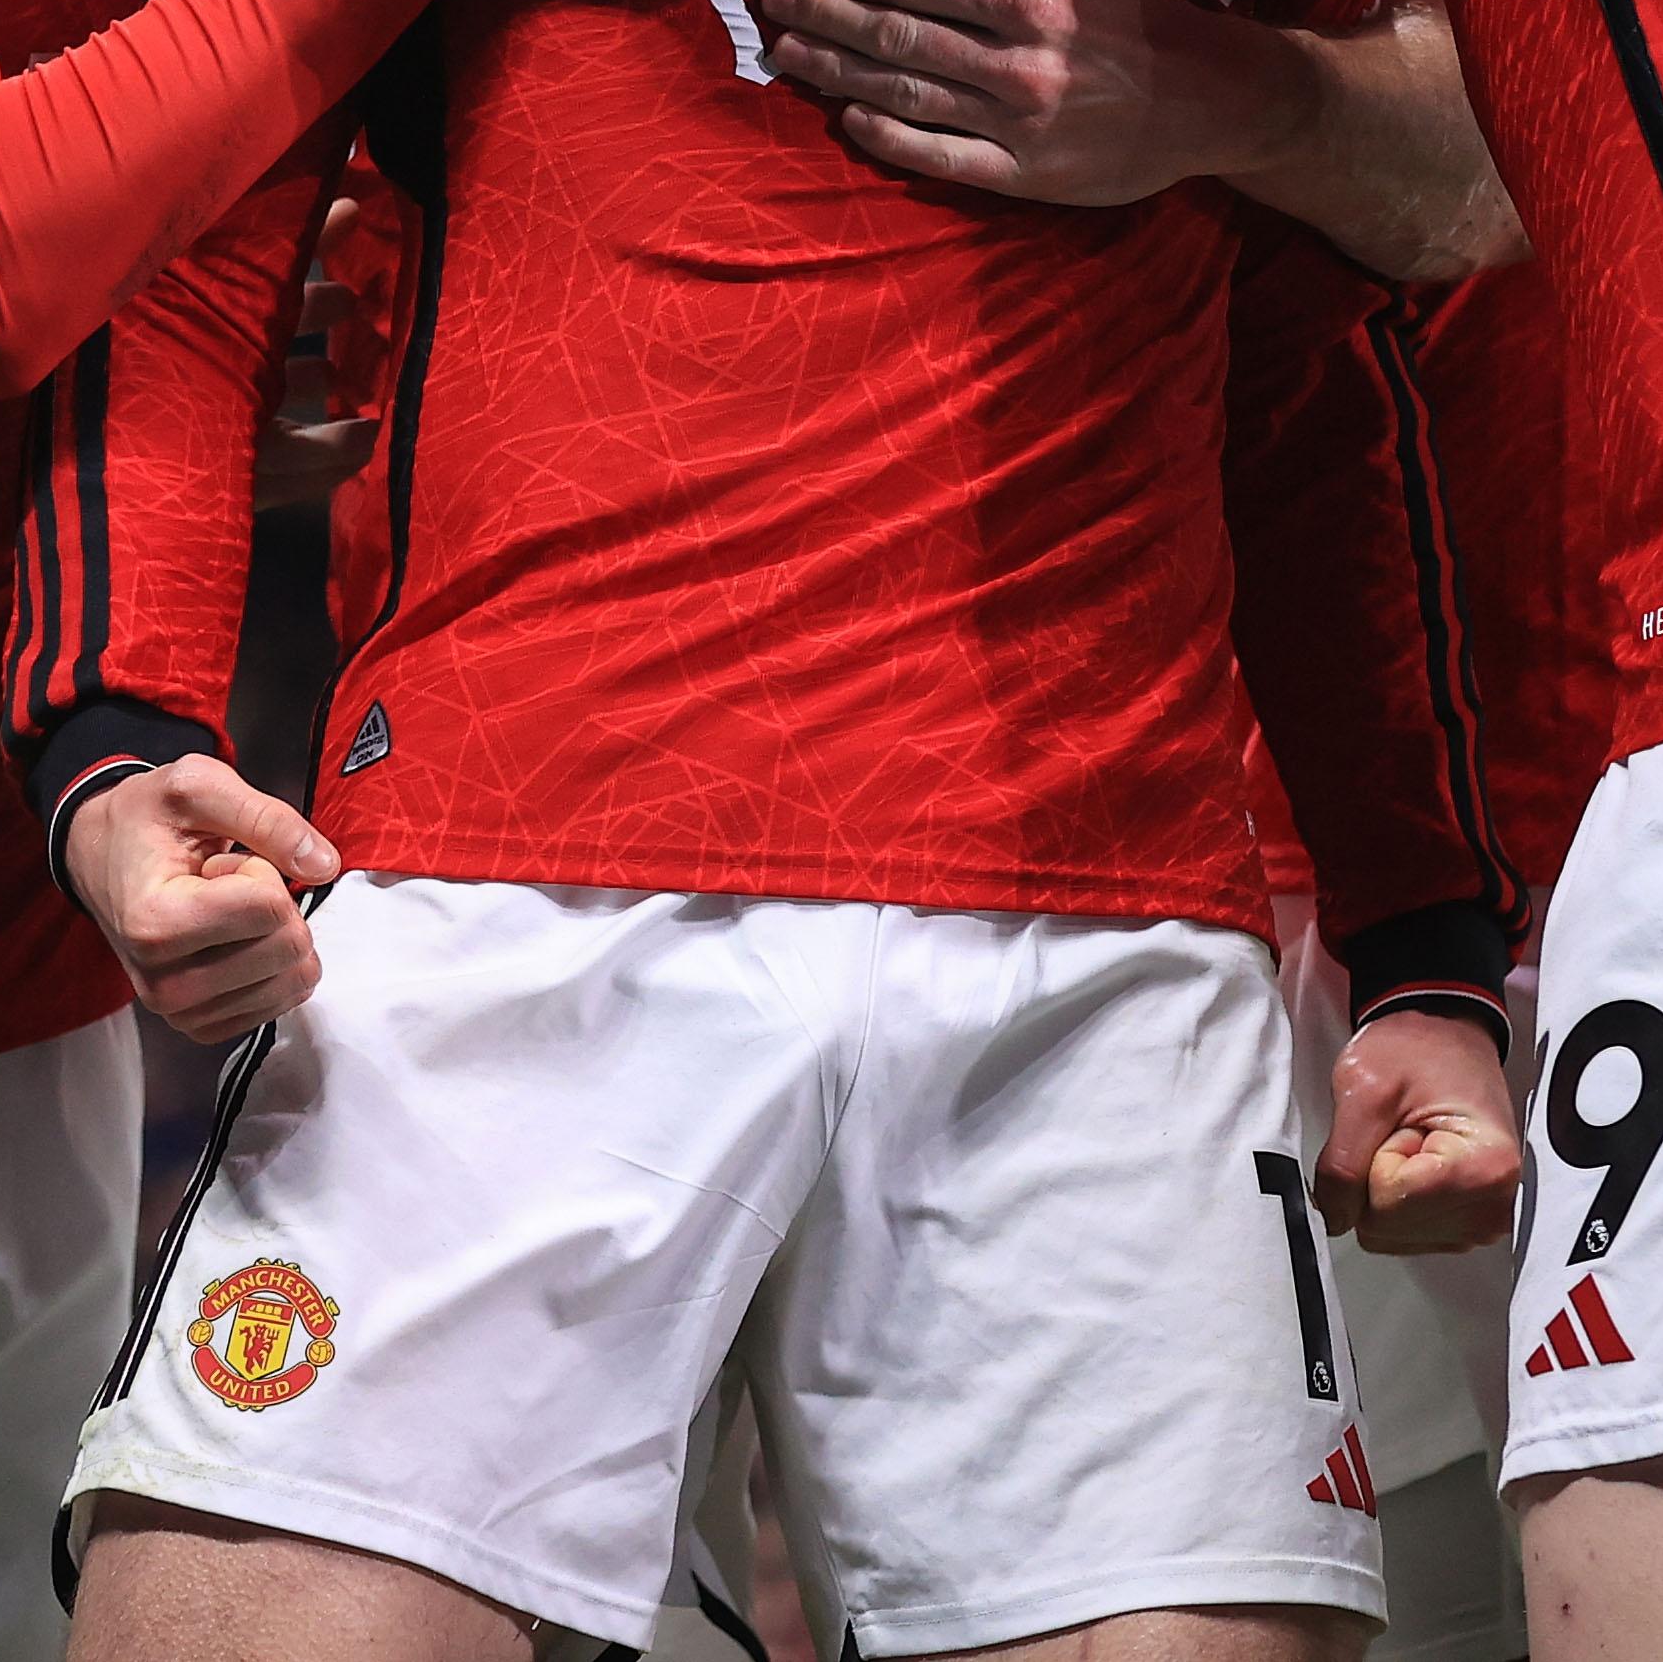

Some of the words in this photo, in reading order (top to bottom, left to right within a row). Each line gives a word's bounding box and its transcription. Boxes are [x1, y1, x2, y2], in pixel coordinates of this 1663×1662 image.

[211, 1270, 326, 1329] MANCHESTER
[1253, 1150, 1358, 1408] 1
[209, 1371, 290, 1401] UNITED
